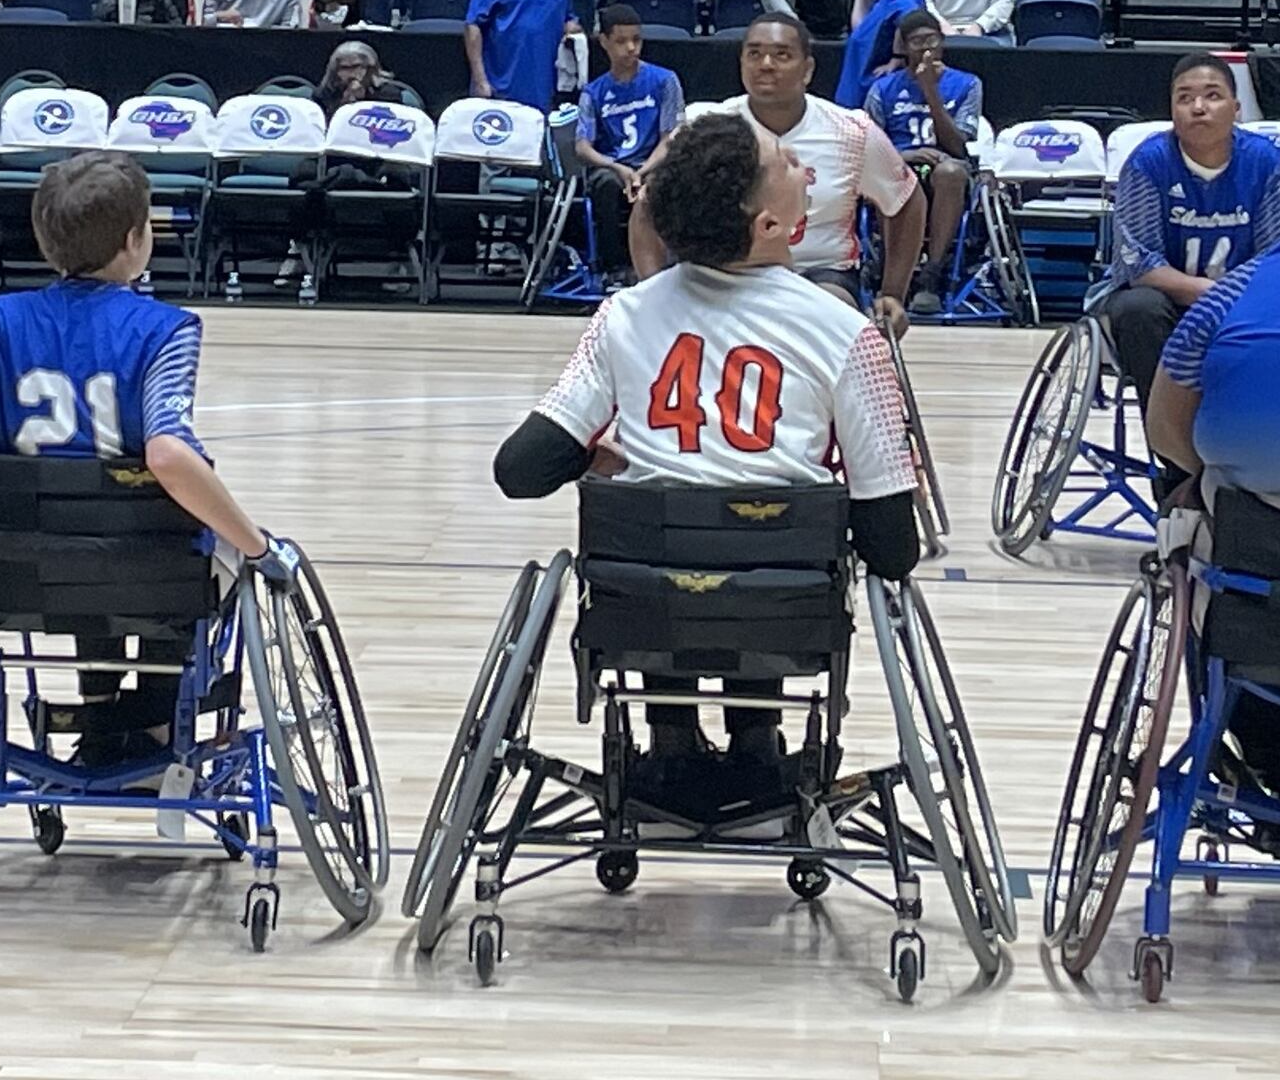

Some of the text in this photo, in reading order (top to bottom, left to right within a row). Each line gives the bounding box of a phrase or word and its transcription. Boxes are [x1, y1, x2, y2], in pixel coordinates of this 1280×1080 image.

[128, 110, 196, 124] GHSA
[349, 114, 415, 134] GHSA
[621, 113, 638, 150] 5
[1015, 133, 1082, 147] GHSA
[648, 331, 786, 453] 40
[15, 368, 123, 460] 21
